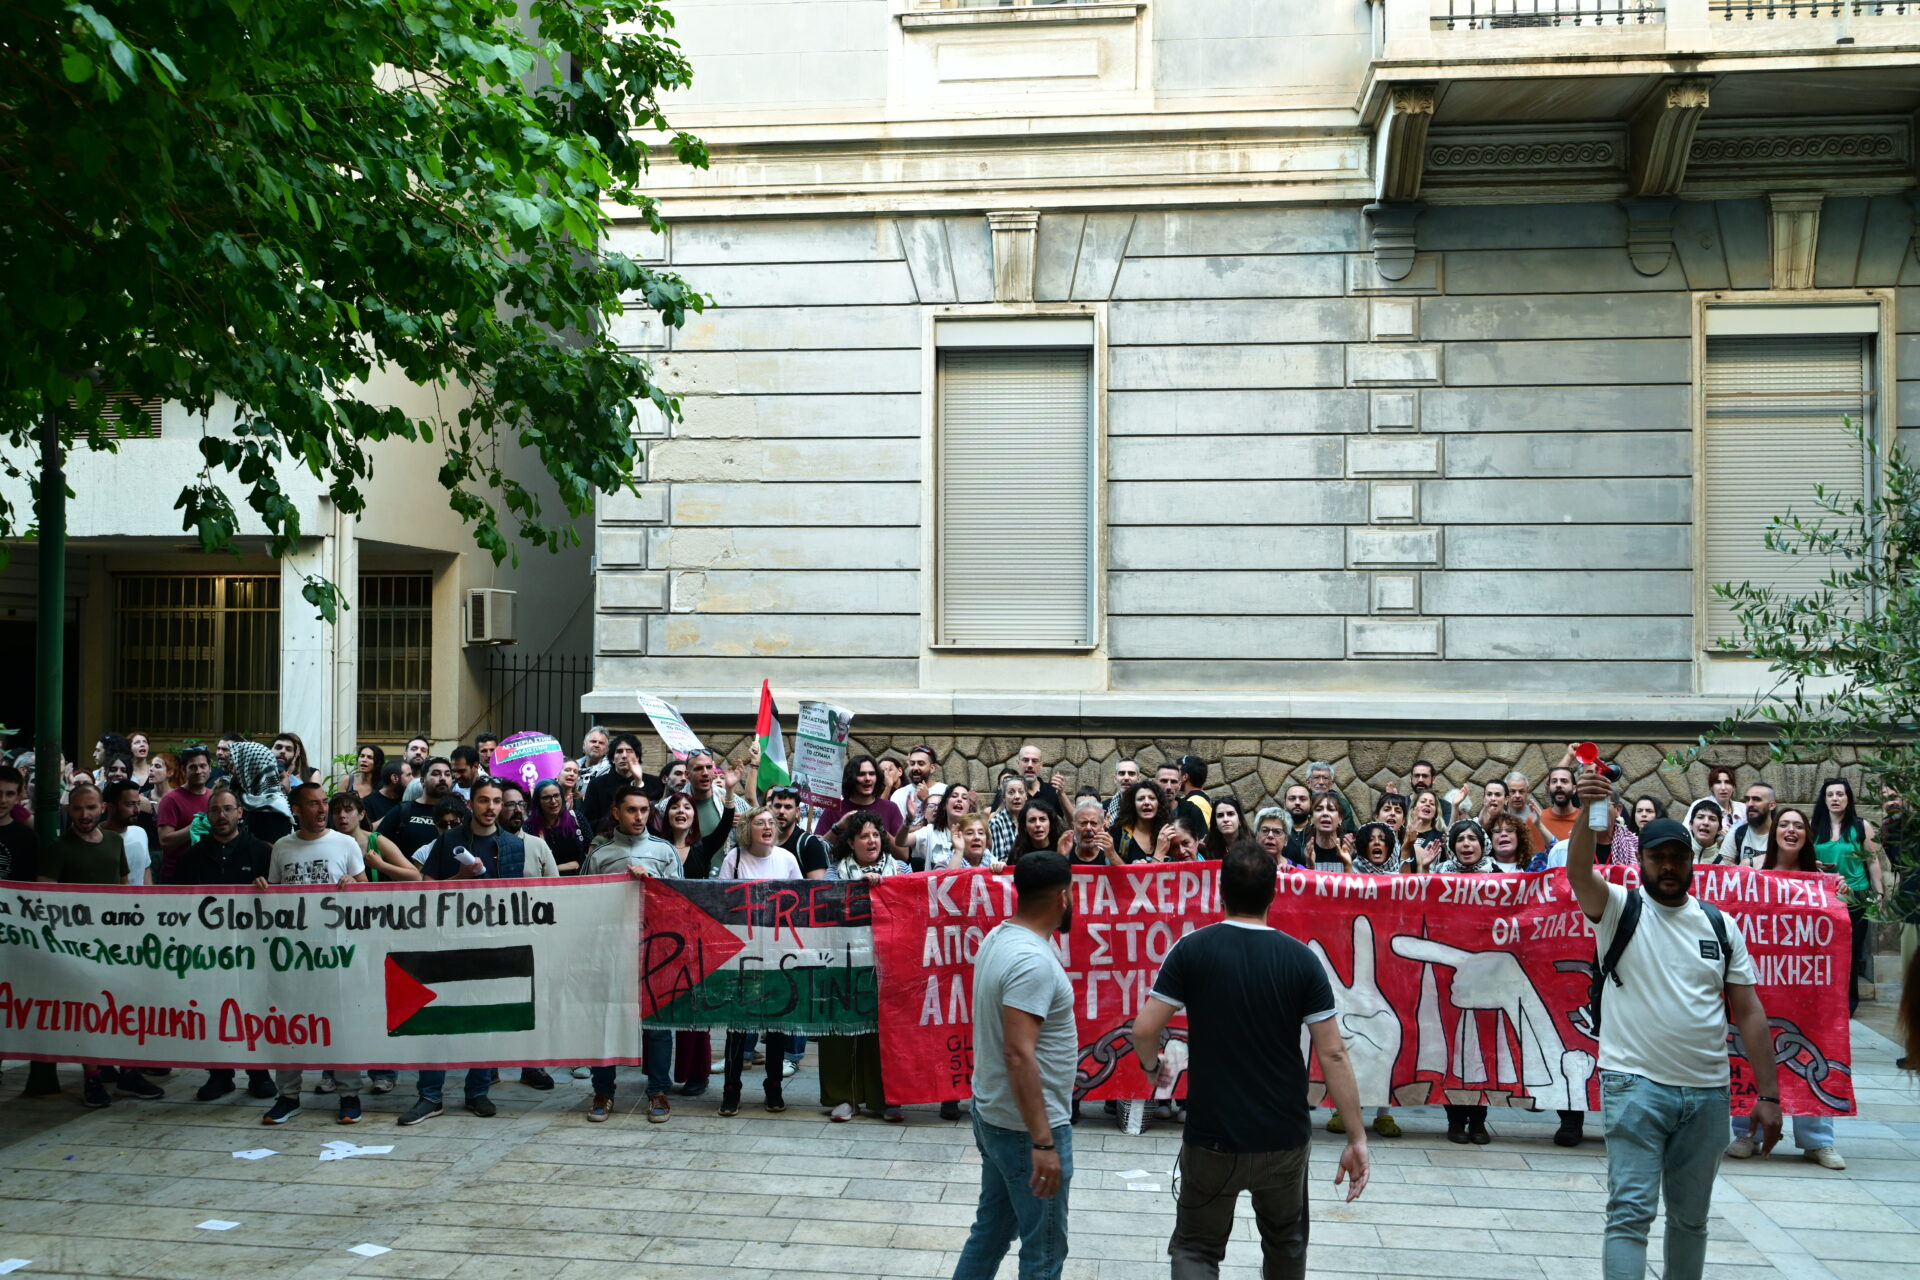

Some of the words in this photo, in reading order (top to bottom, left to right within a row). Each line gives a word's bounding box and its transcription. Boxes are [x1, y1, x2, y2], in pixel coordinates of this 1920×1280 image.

[311, 873, 330, 881] GAZA
[927, 874, 1015, 918] ΚΑΤ
[1072, 873, 1119, 915] ΤΑ
[1276, 870, 1306, 895] ΤΟ
[1315, 874, 1377, 900] ΚΥΜΑ
[1391, 875, 1433, 901] ΠΟΥ
[1693, 870, 1828, 908] ΤΑΜΑΤΗΣΕΙ
[101, 903, 145, 927] από
[157, 911, 192, 927] τον
[198, 896, 308, 930] Global
[320, 893, 427, 930] Sumud
[437, 891, 557, 928] Flotilla
[725, 879, 871, 949] FREE
[0, 921, 40, 950] εση
[1491, 917, 1521, 945] ΘΑ
[639, 931, 879, 1023] PALESTINE
[0, 982, 206, 1046] Αντιπολεμική
[219, 998, 331, 1052] Δράση
